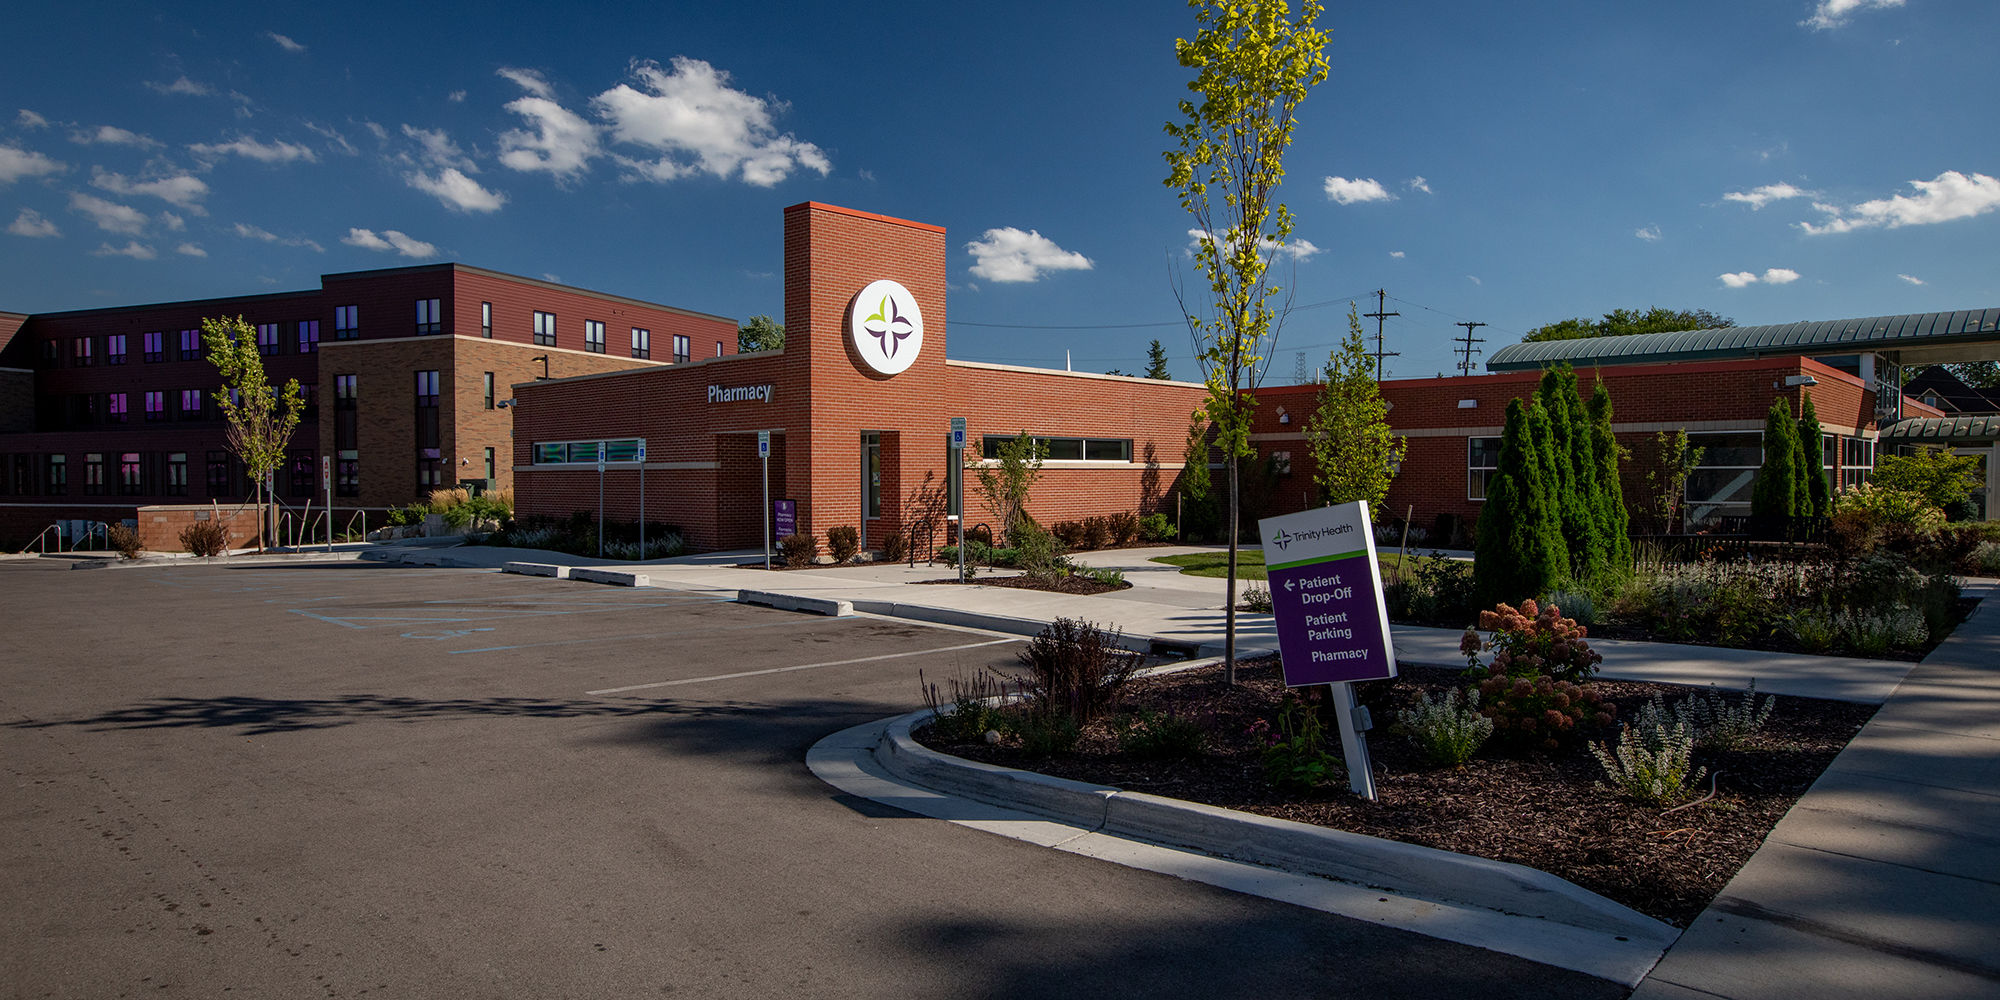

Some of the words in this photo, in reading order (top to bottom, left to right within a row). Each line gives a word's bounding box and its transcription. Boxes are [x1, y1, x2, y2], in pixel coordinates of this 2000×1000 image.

[708, 384, 771, 403] Pharmacy
[1293, 530, 1321, 542] Trinity
[1321, 524, 1353, 537] Health
[1299, 574, 1341, 589] Patient
[1302, 587, 1352, 604] Drop-Off
[1305, 612, 1348, 626] Patient
[1308, 628, 1352, 641] Parking
[1311, 648, 1368, 662] Pharmacy
